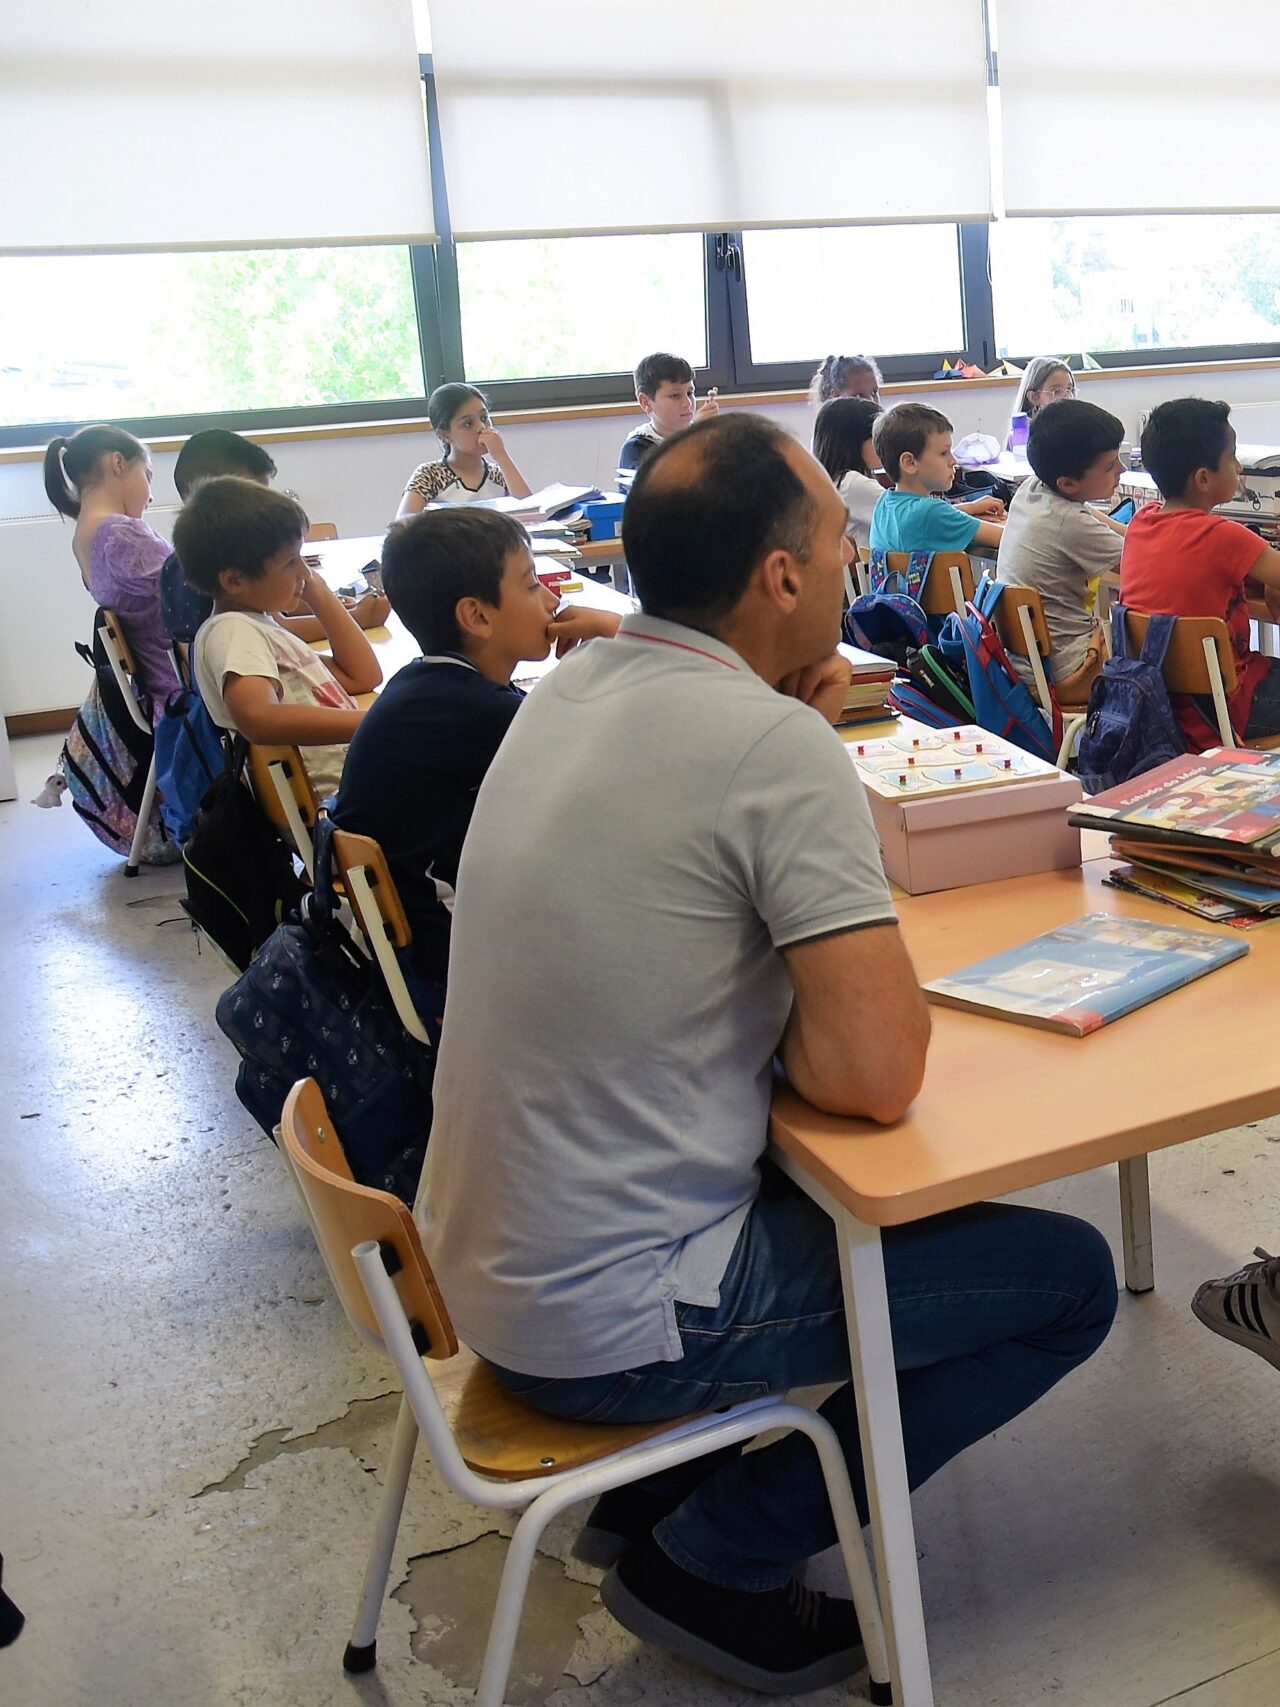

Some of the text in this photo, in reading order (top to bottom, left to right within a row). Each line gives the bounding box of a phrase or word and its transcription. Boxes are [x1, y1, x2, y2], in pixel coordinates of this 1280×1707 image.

[1119, 785, 1163, 807] Estudo
[1162, 776, 1180, 791] do
[1176, 765, 1208, 784] Meio
